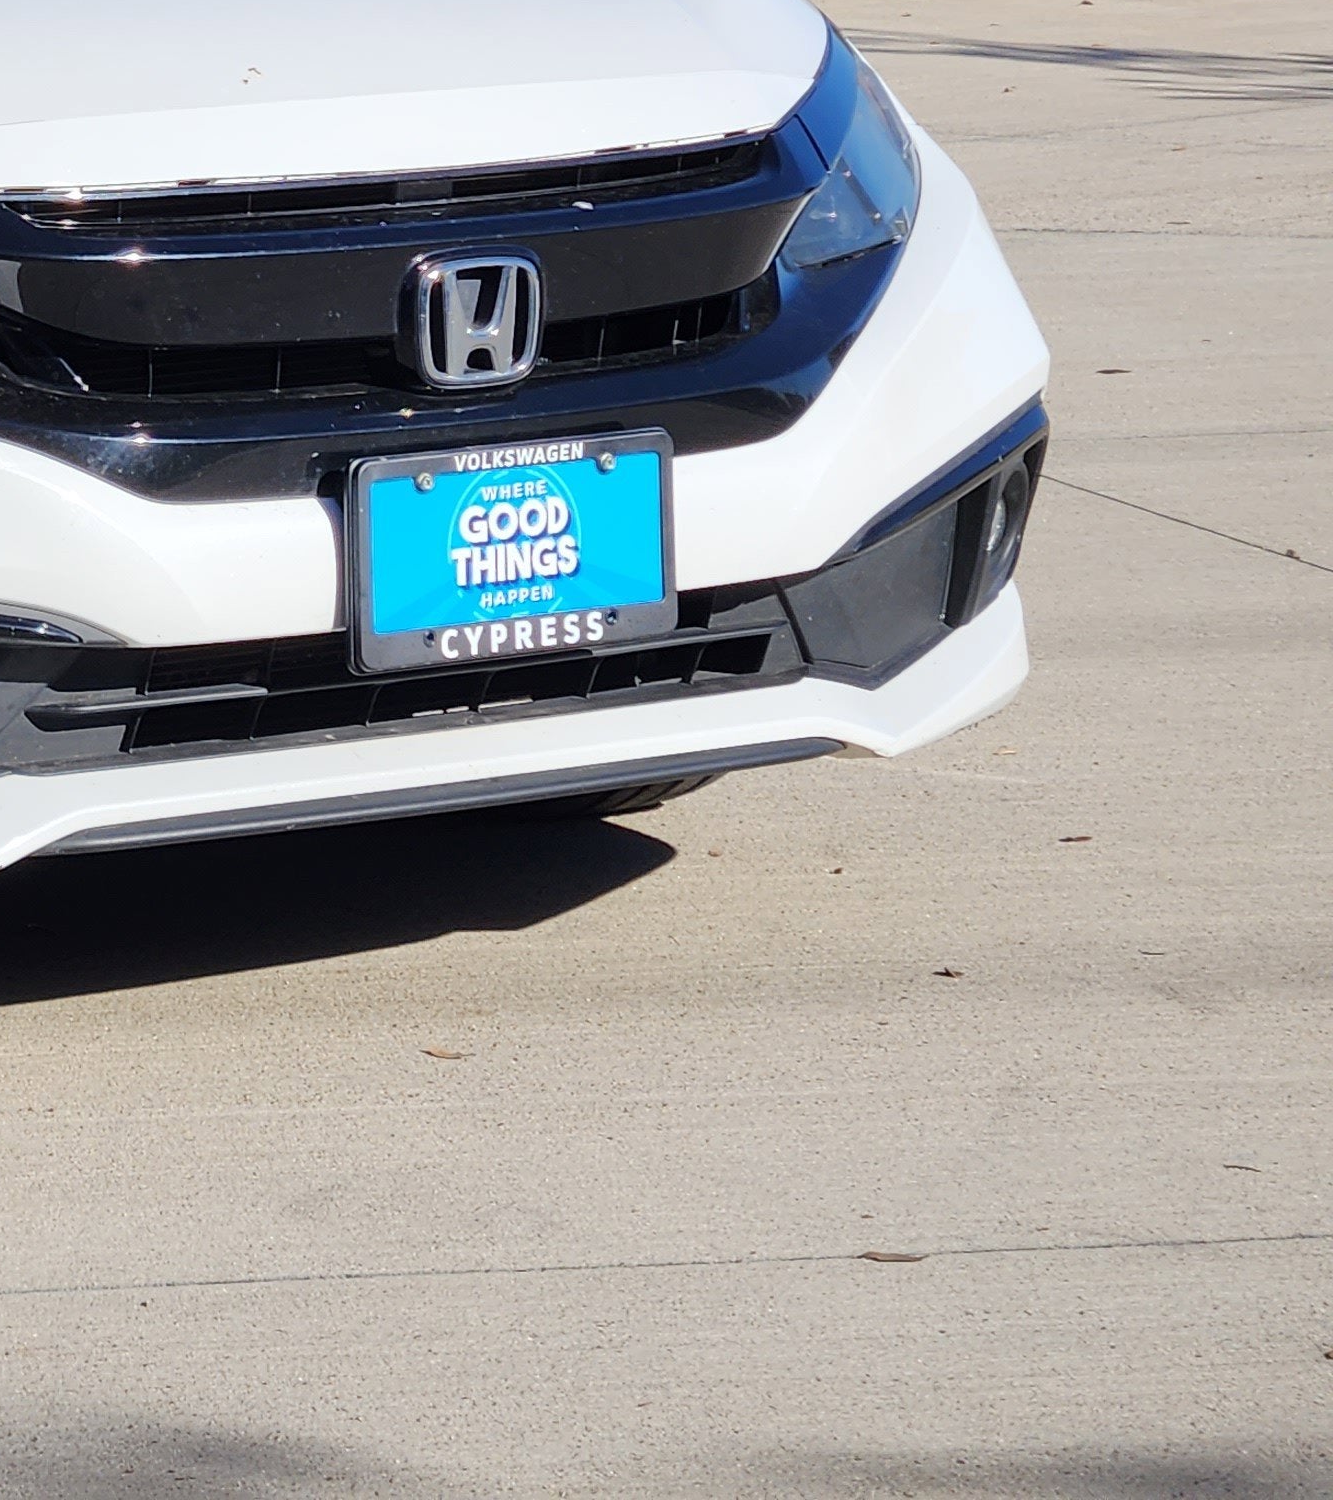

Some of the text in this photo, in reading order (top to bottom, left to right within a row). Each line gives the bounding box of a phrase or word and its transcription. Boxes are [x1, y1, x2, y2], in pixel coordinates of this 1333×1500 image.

[454, 442, 584, 472] VOLKSWAGEN
[481, 479, 548, 502] WHERE
[459, 496, 570, 544] GOOD
[450, 534, 580, 587] THINGS
[479, 584, 553, 609] HAPPEN
[440, 610, 604, 660] CYPRESS
